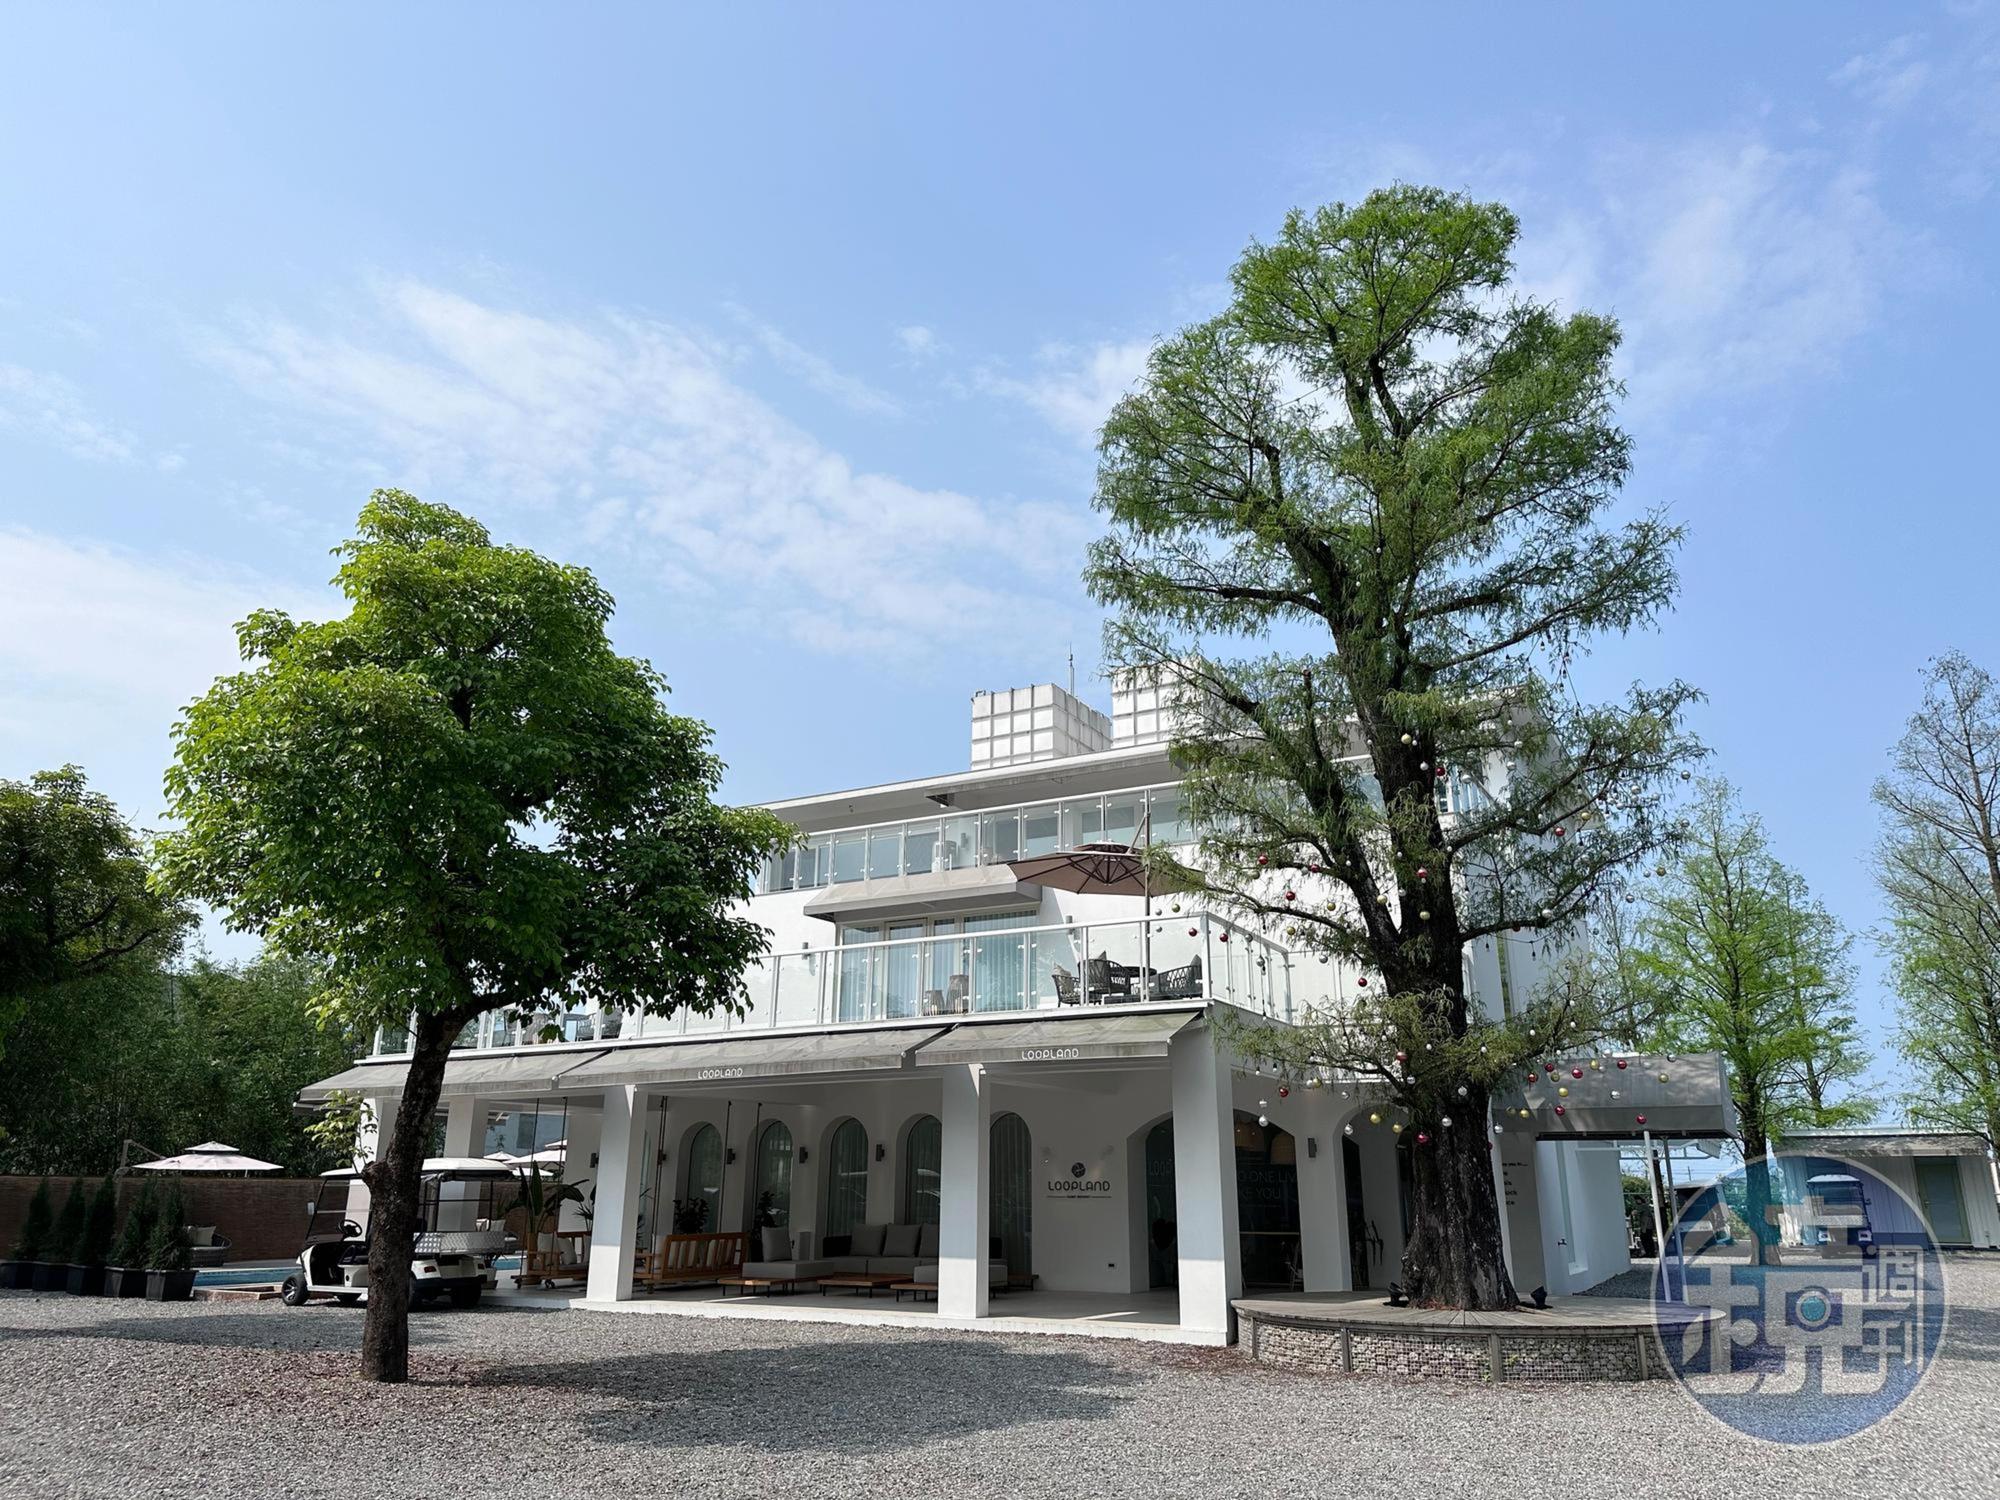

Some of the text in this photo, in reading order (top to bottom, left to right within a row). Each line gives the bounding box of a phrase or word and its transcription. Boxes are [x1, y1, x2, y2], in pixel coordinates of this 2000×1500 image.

[1021, 1048, 1079, 1060] LOOPLAND
[697, 1067, 743, 1080] LOOPLAND
[1048, 1180, 1110, 1192] LOOPLAND
